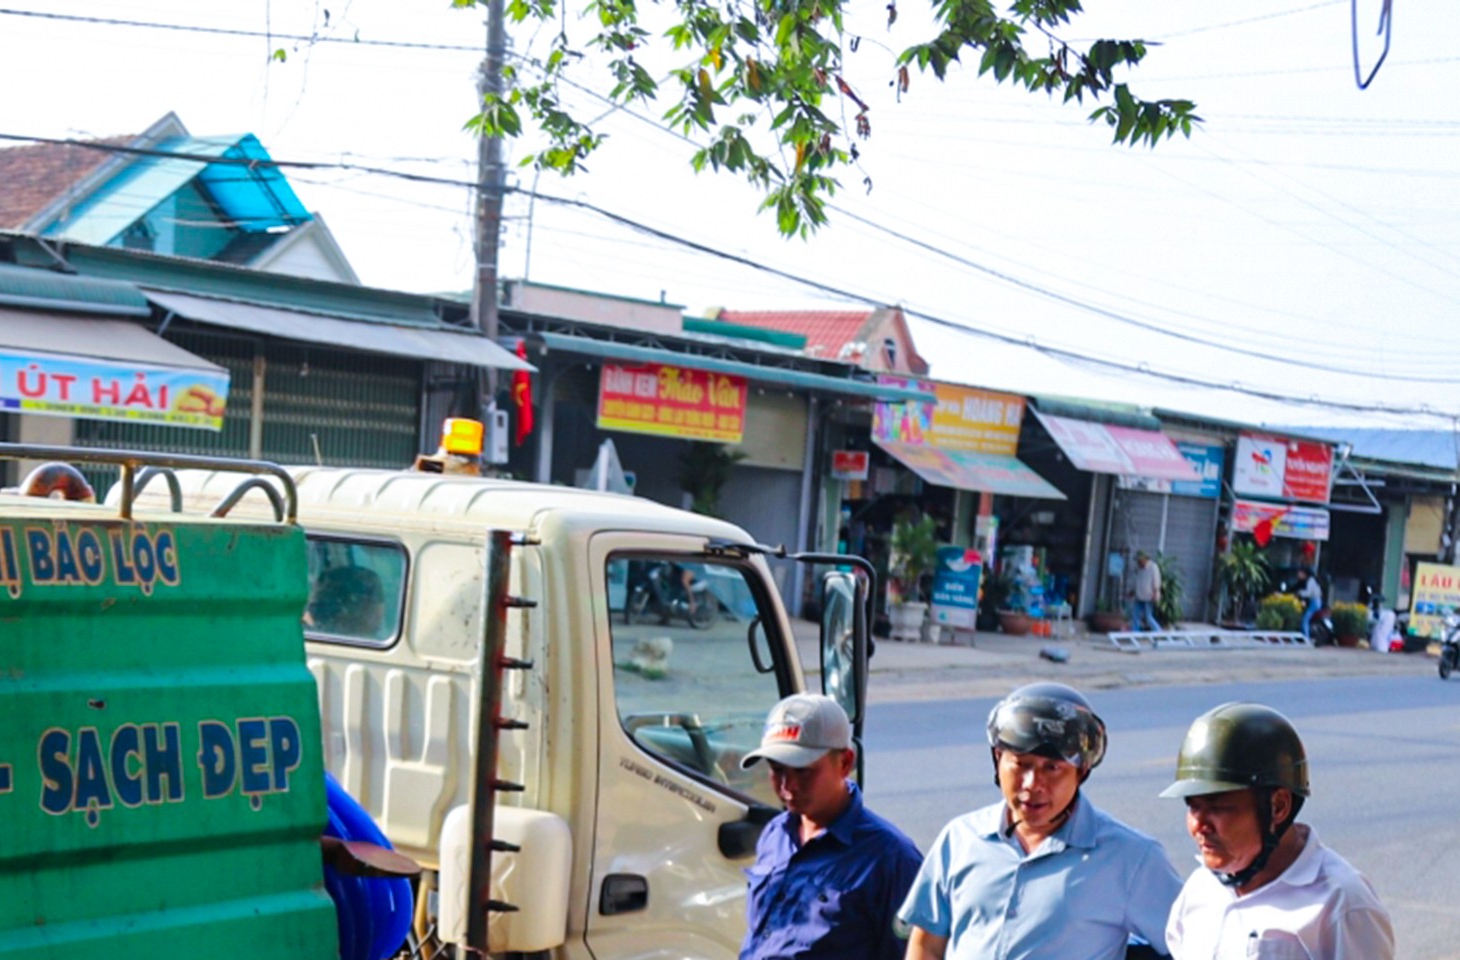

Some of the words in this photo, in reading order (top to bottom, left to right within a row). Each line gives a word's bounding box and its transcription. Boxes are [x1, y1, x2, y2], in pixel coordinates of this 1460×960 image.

[17, 364, 77, 401] ÚT
[92, 372, 169, 411] HẢI
[108, 519, 181, 596] LỘC
[38, 721, 185, 828] SẠCH
[197, 715, 301, 811] ĐẸP
